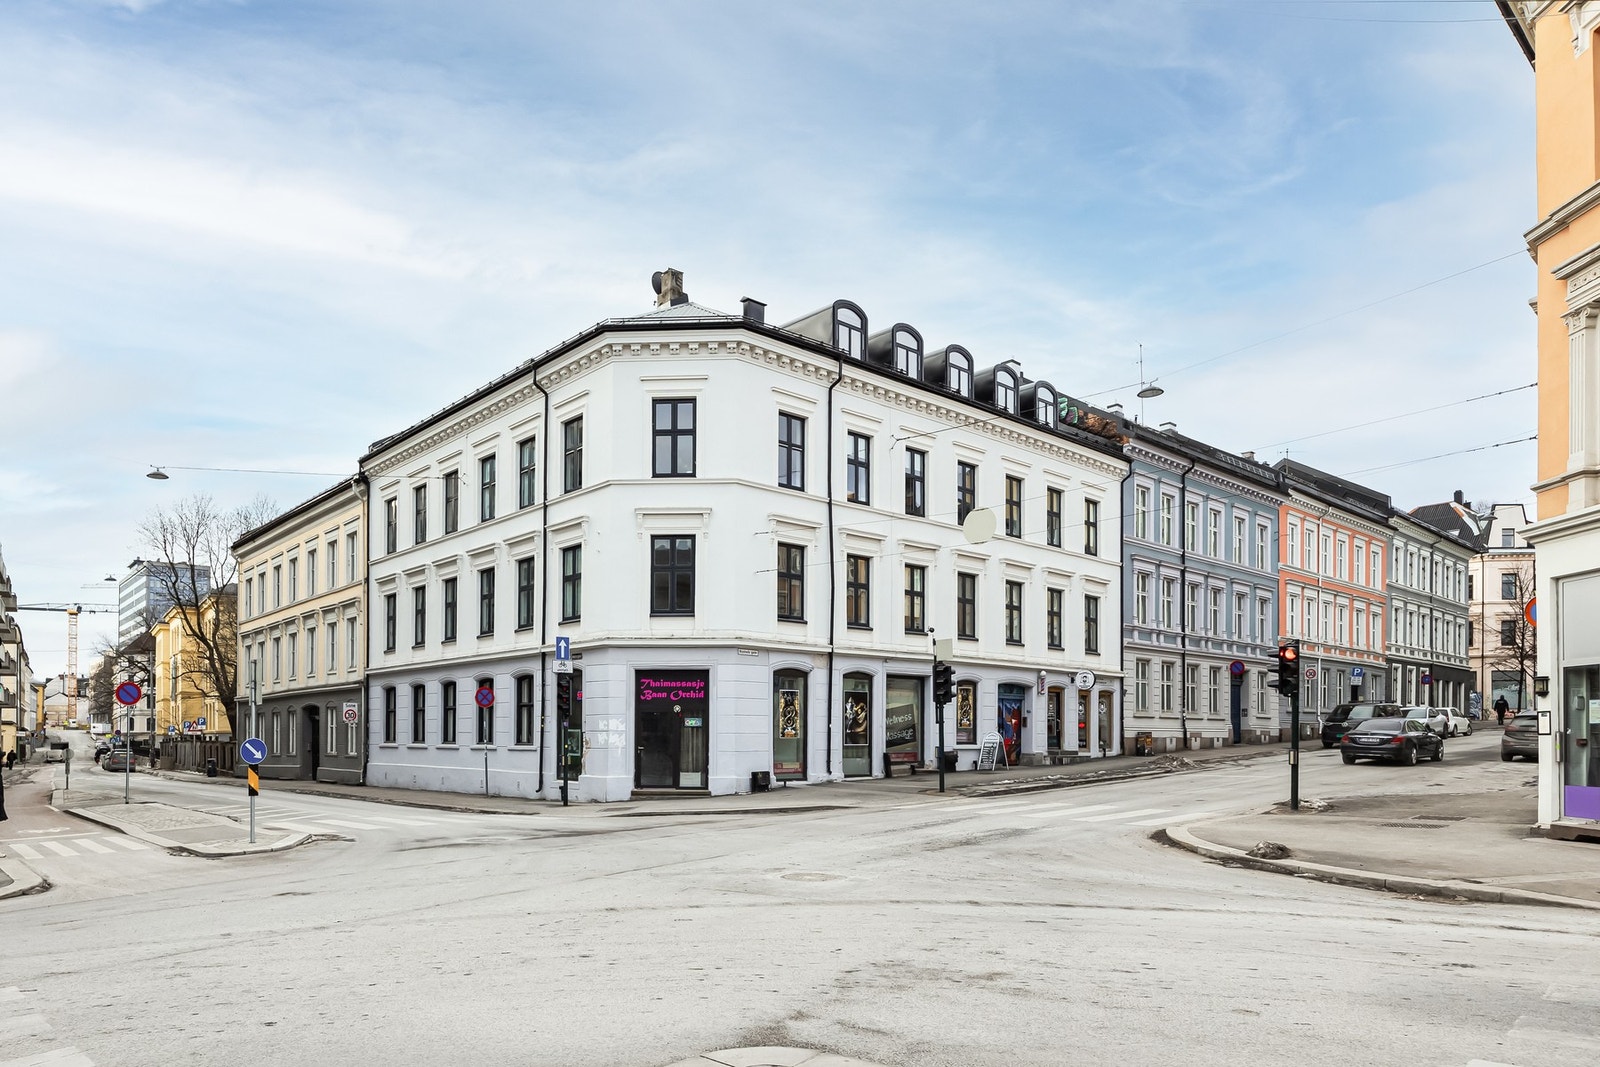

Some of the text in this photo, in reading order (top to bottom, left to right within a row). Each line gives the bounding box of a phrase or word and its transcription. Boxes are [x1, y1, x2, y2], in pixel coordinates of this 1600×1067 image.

[640, 679, 705, 689] Thaimassasje
[640, 690, 704, 700] Baan Orchid
